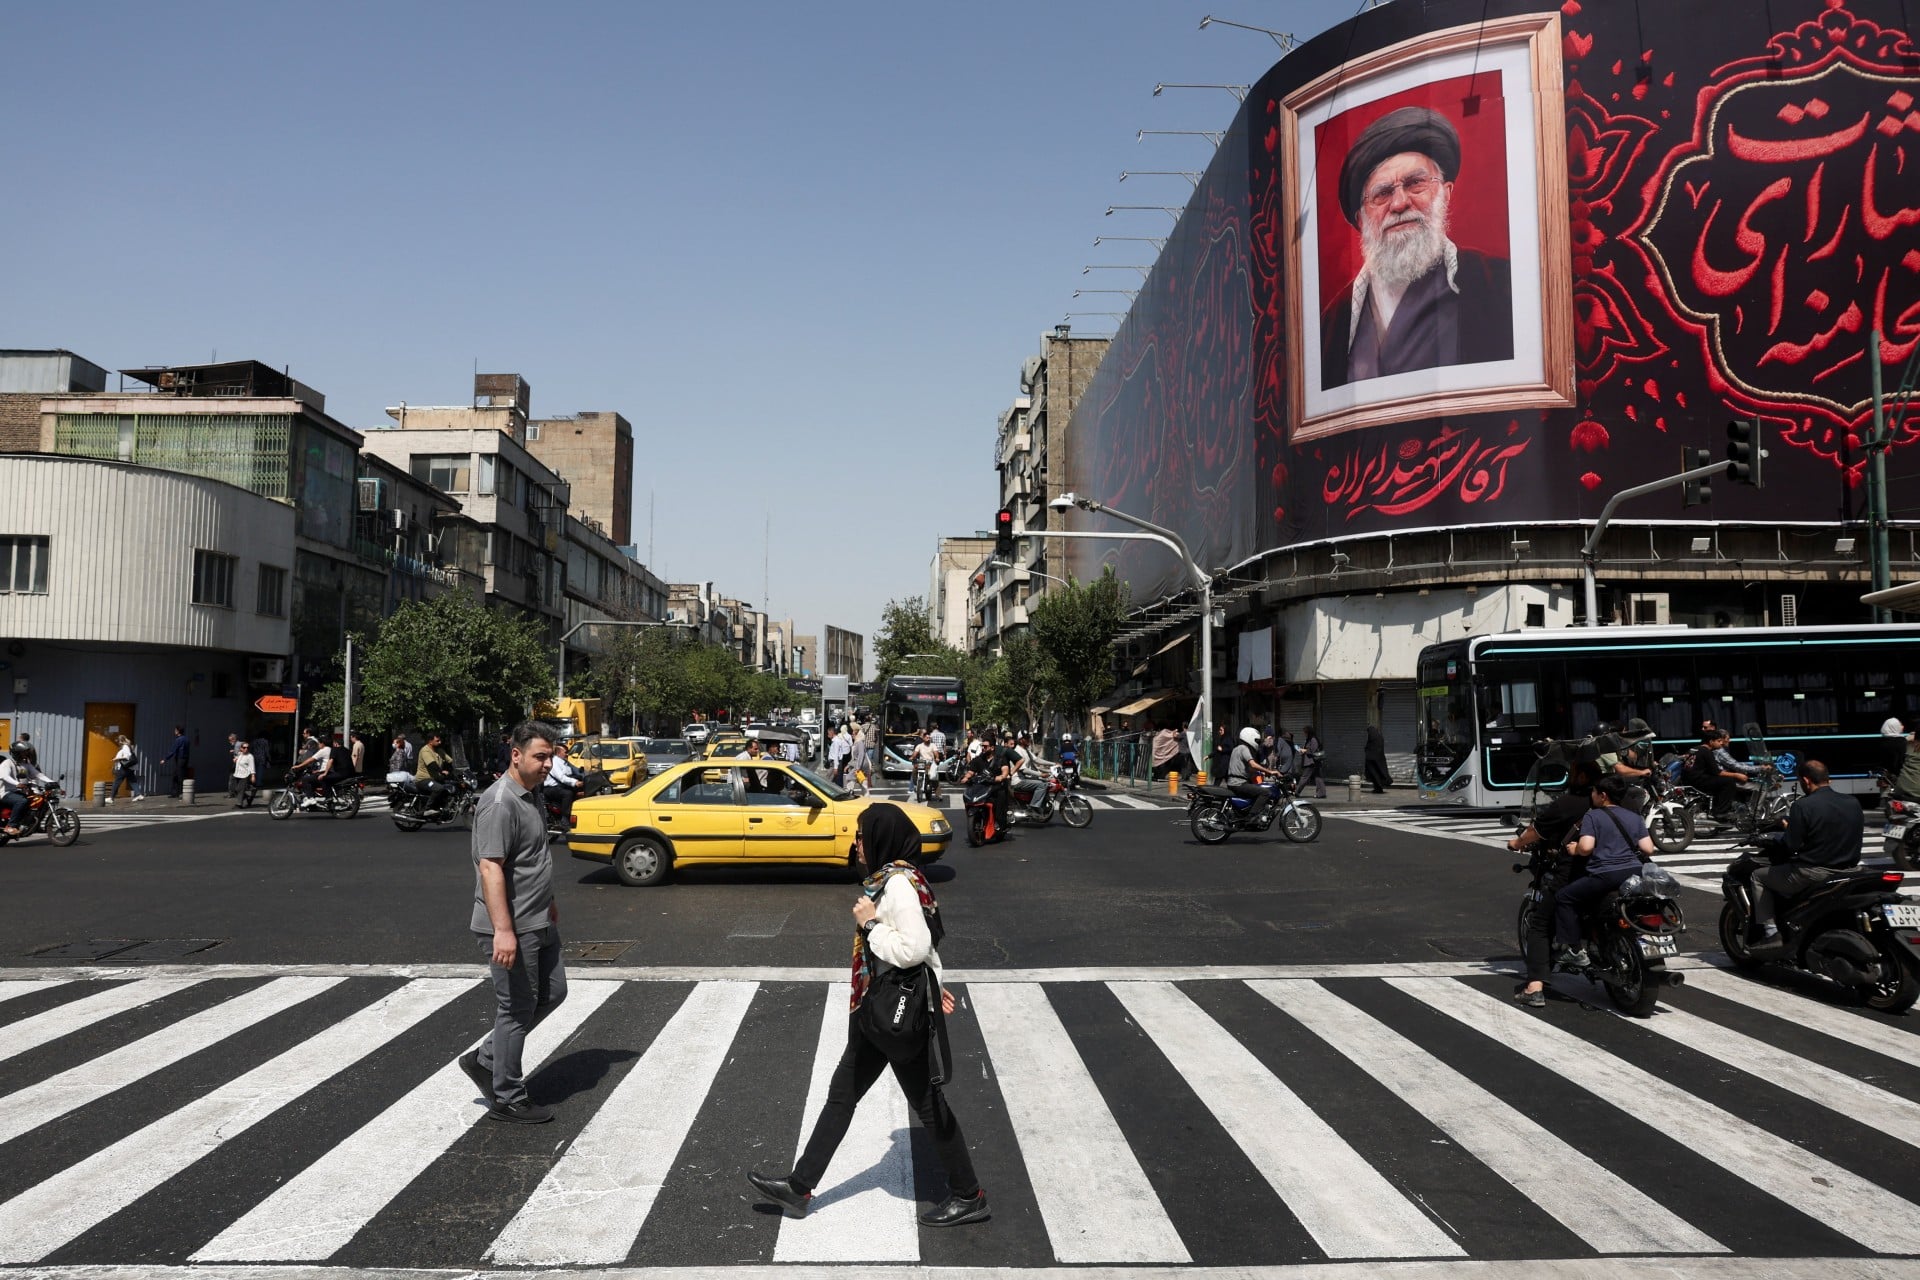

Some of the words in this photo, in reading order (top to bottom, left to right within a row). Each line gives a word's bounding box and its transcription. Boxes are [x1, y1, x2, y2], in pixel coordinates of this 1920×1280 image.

[1322, 441, 1389, 522] ایران
[1371, 425, 1469, 503] شهید
[1371, 434, 1532, 516] آقای
[893, 995, 906, 1024] adidas
